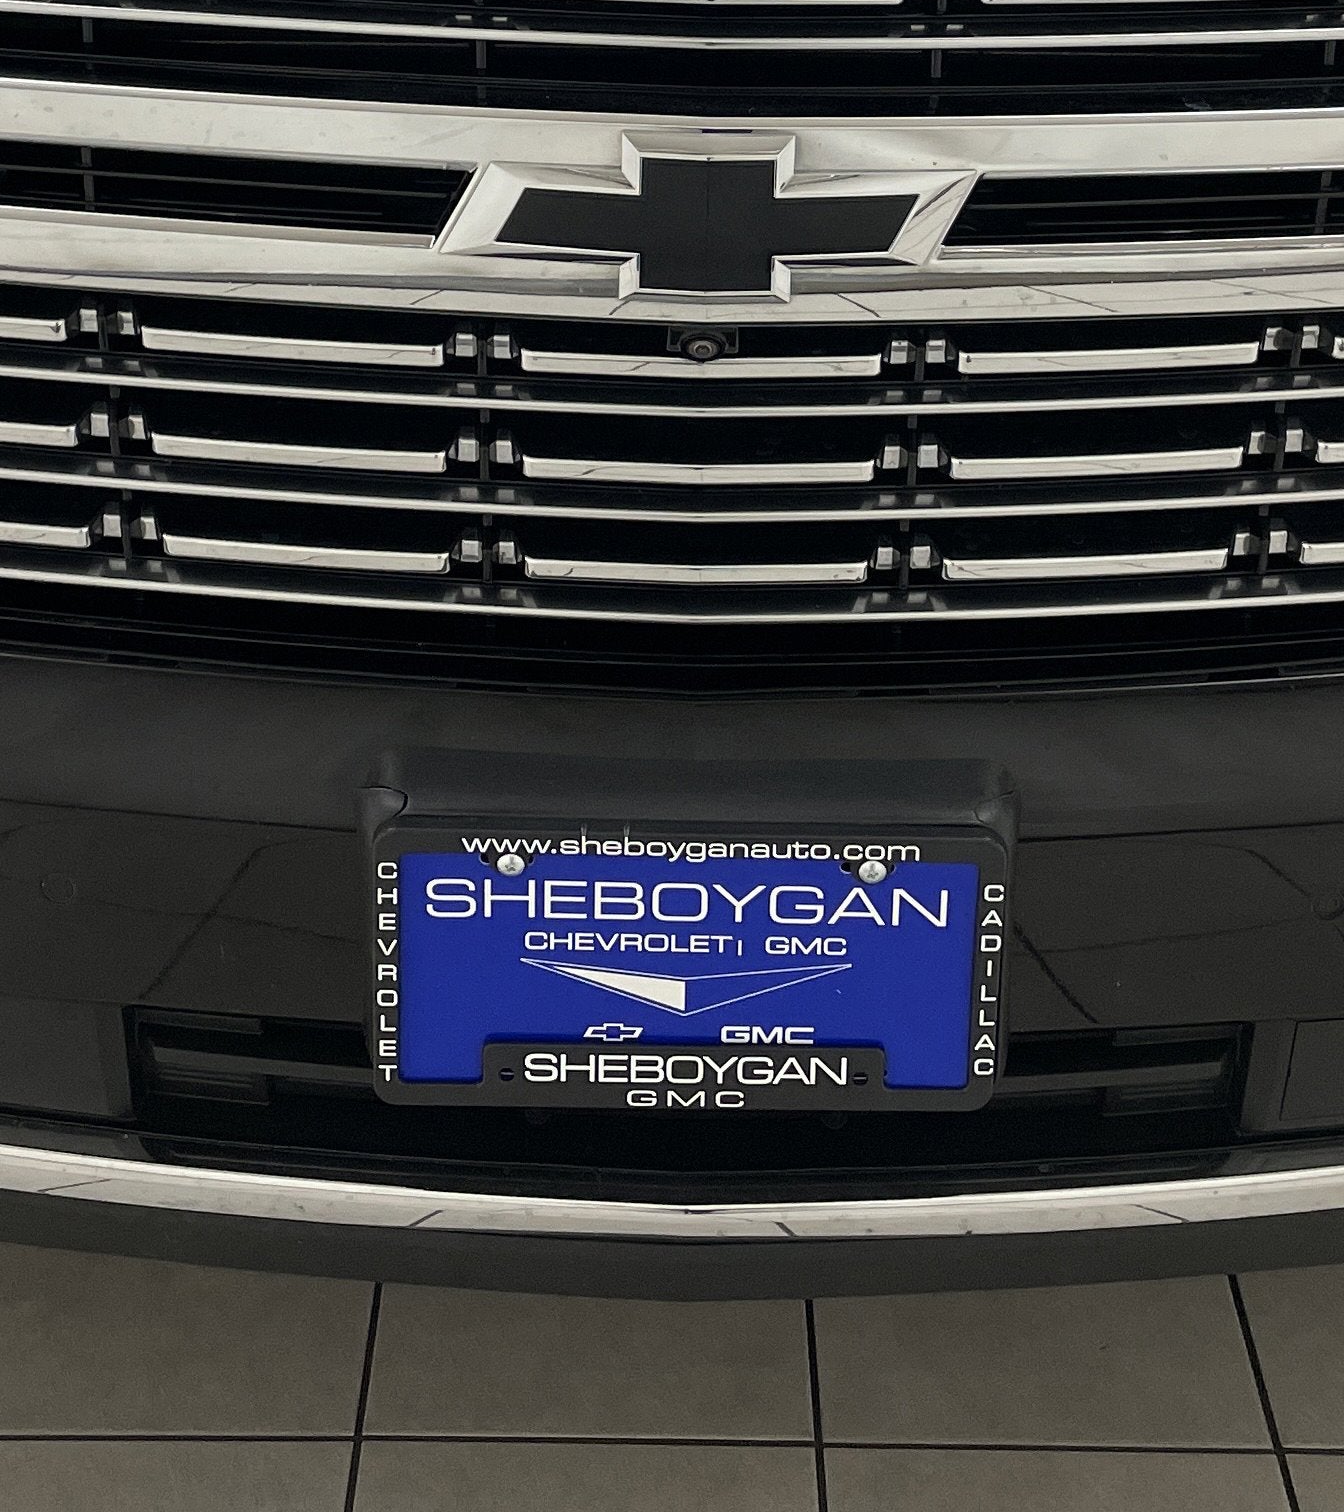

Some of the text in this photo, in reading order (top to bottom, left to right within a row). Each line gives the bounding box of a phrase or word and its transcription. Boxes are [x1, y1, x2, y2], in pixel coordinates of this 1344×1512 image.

[462, 836, 920, 861] www.sheboyganauto.com
[425, 879, 948, 927] SHEBOYGAN
[525, 932, 847, 956] CHEVROLET GMC
[378, 863, 398, 1080] CHEVROLET
[974, 885, 1004, 1076] CADILLAC
[721, 1025, 815, 1045] GMC
[524, 1054, 848, 1085] SHEBOYGAN
[626, 1090, 745, 1109] GMC
